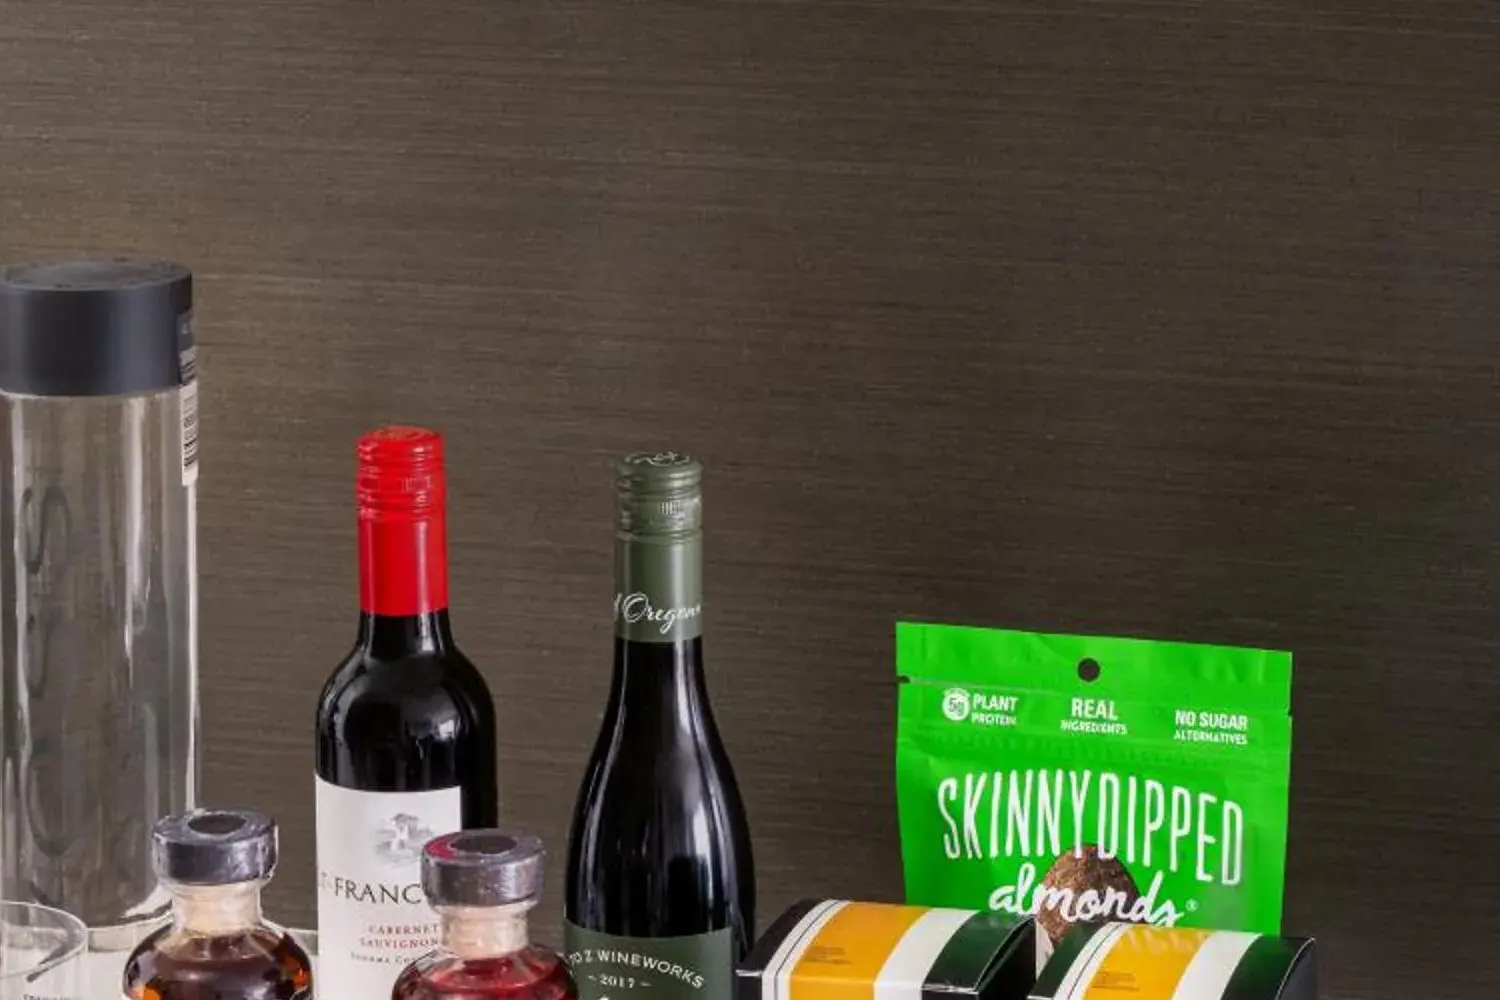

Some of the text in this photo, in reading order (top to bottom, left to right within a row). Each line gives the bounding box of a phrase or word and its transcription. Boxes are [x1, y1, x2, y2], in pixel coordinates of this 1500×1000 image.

[972, 694, 1019, 711] PLANT
[1071, 697, 1118, 720] REAL
[1174, 709, 1248, 731] NO SUGAR
[334, 877, 421, 905] FRANC
[988, 863, 1185, 928] almonds
[597, 949, 705, 989] WINEWORKS
